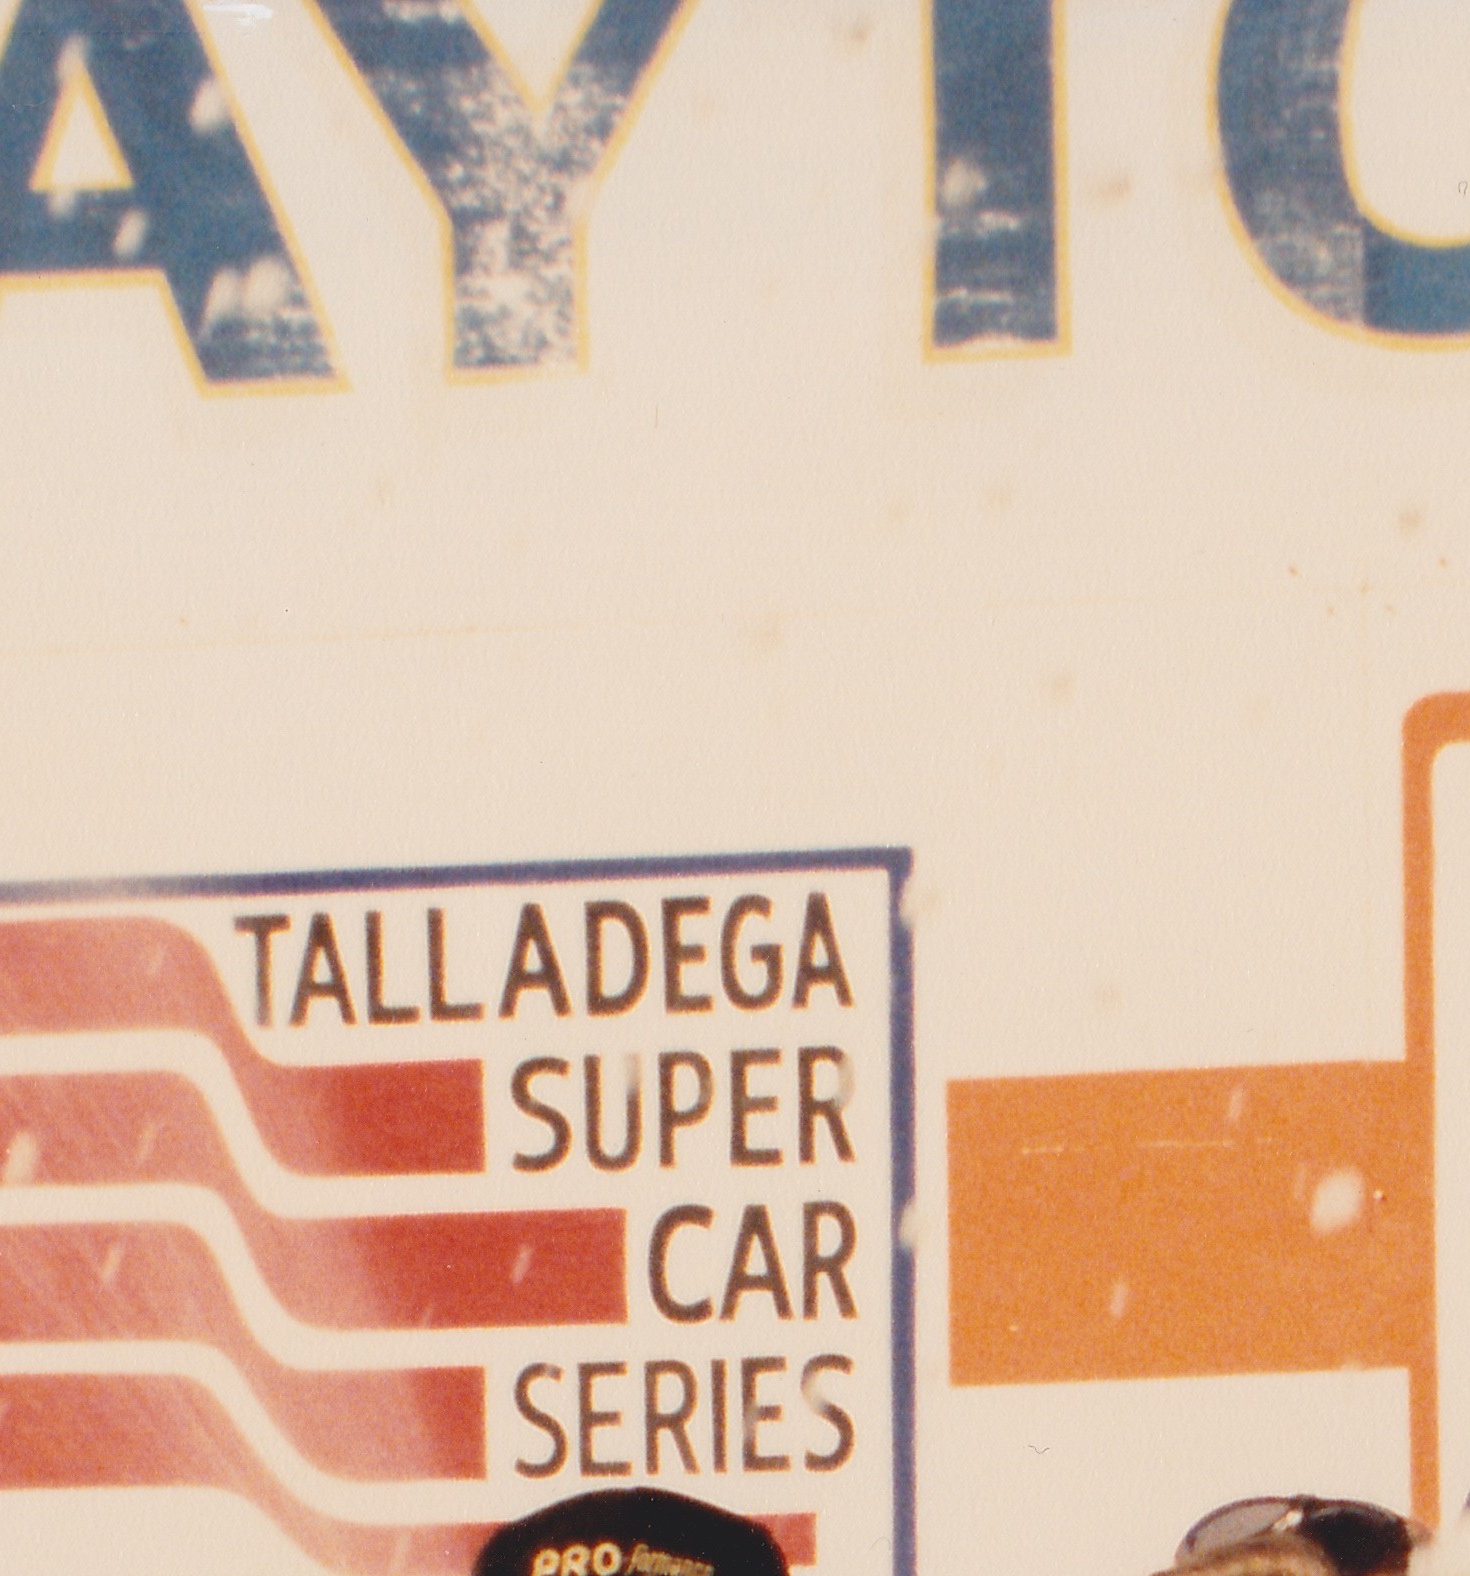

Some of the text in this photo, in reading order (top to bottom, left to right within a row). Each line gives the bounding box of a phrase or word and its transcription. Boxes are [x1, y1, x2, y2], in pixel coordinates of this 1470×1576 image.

[234, 892, 856, 1028] TALLADEGA
[509, 1045, 856, 1173] SUPER
[646, 1200, 859, 1324] CAR
[513, 1354, 855, 1480] SERIES
